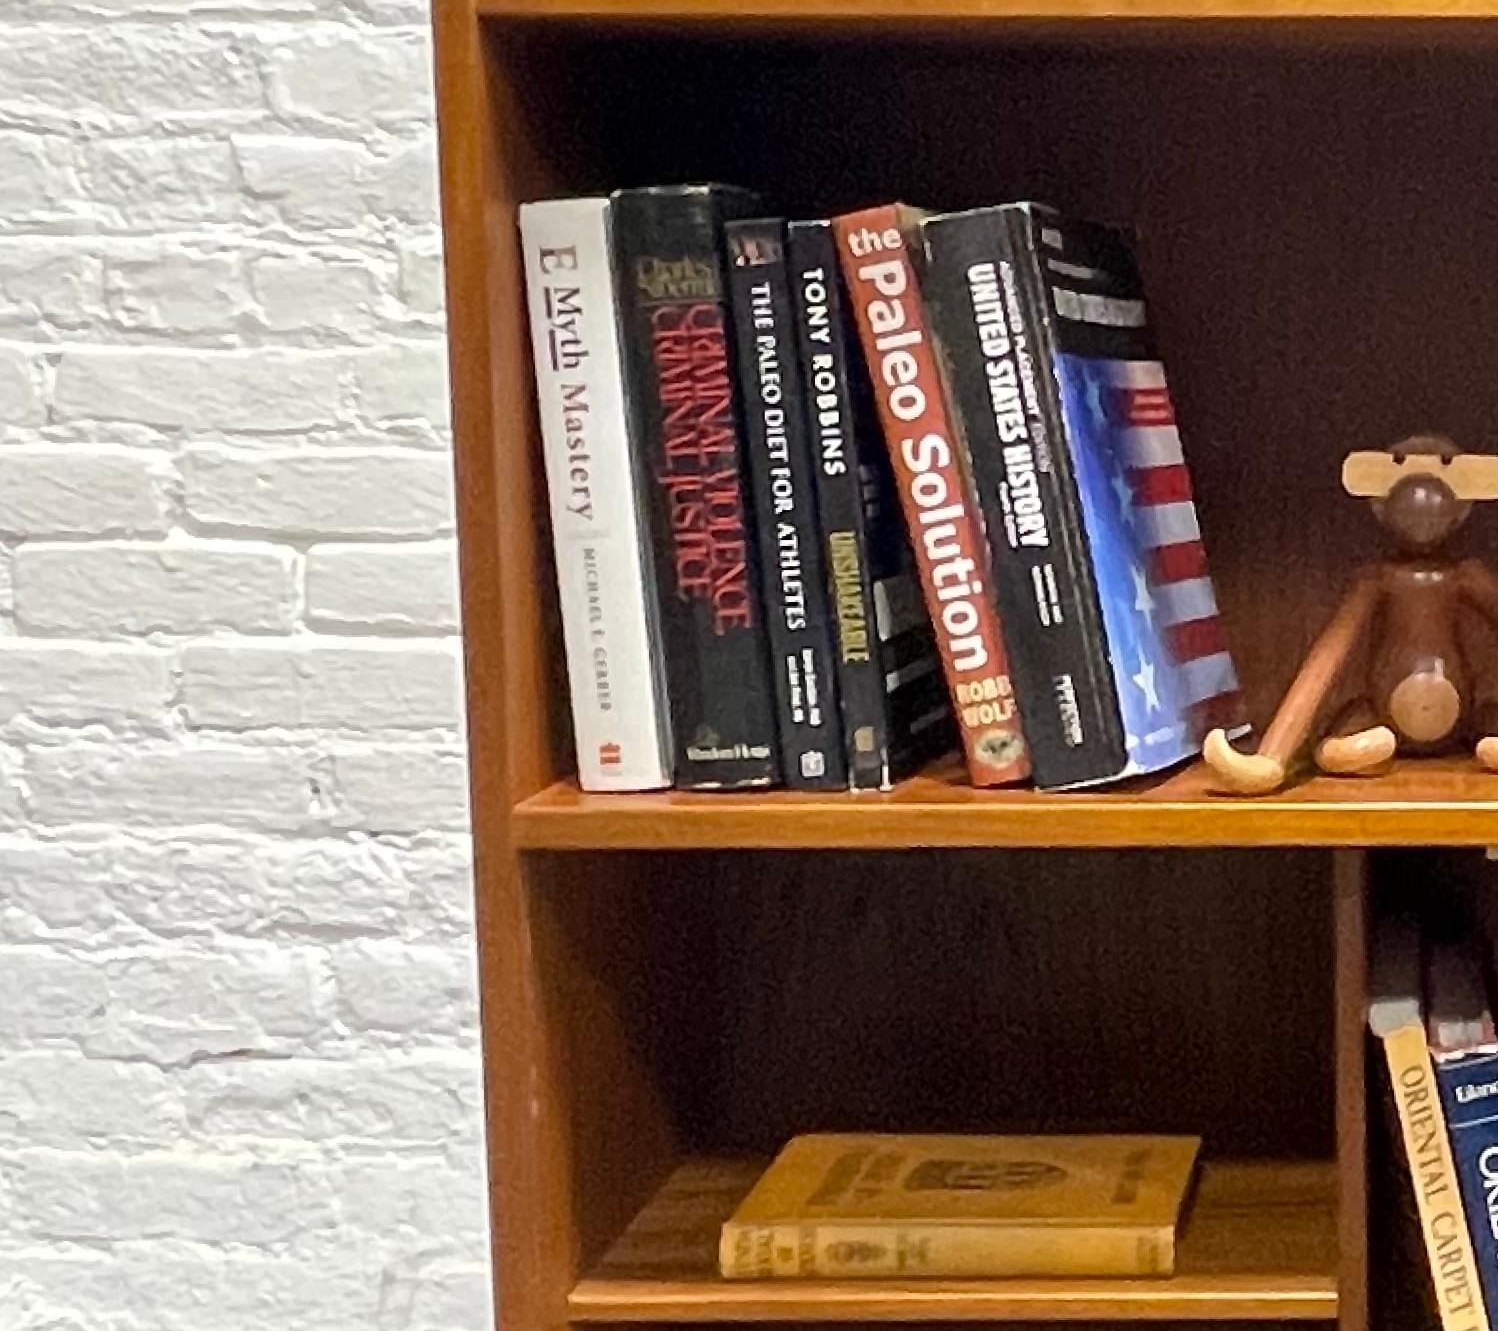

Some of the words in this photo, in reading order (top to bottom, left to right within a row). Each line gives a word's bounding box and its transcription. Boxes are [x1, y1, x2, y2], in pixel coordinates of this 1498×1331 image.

[538, 244, 578, 275] E
[848, 226, 903, 258] the
[551, 286, 590, 370] Myth
[751, 280, 775, 330] THE
[802, 267, 832, 345] TONY
[966, 262, 1012, 358] UNITED
[652, 306, 701, 469] CRIMINAL
[688, 304, 736, 468] CRIMINAL
[756, 334, 783, 406] PALEO
[812, 352, 848, 477] ROBBINS
[985, 357, 1029, 444] STATES
[560, 383, 594, 522] Mastery
[764, 409, 790, 464] DIET
[858, 258, 927, 422] Paleo
[901, 433, 989, 673] Solution
[658, 473, 712, 602] JUSTICE
[769, 467, 795, 516] FOR
[1002, 443, 1050, 548] HISTORY
[777, 521, 807, 631] ATHLETES
[1399, 1063, 1451, 1206] ORIENTAL
[1430, 1211, 1477, 1319] CARPET
